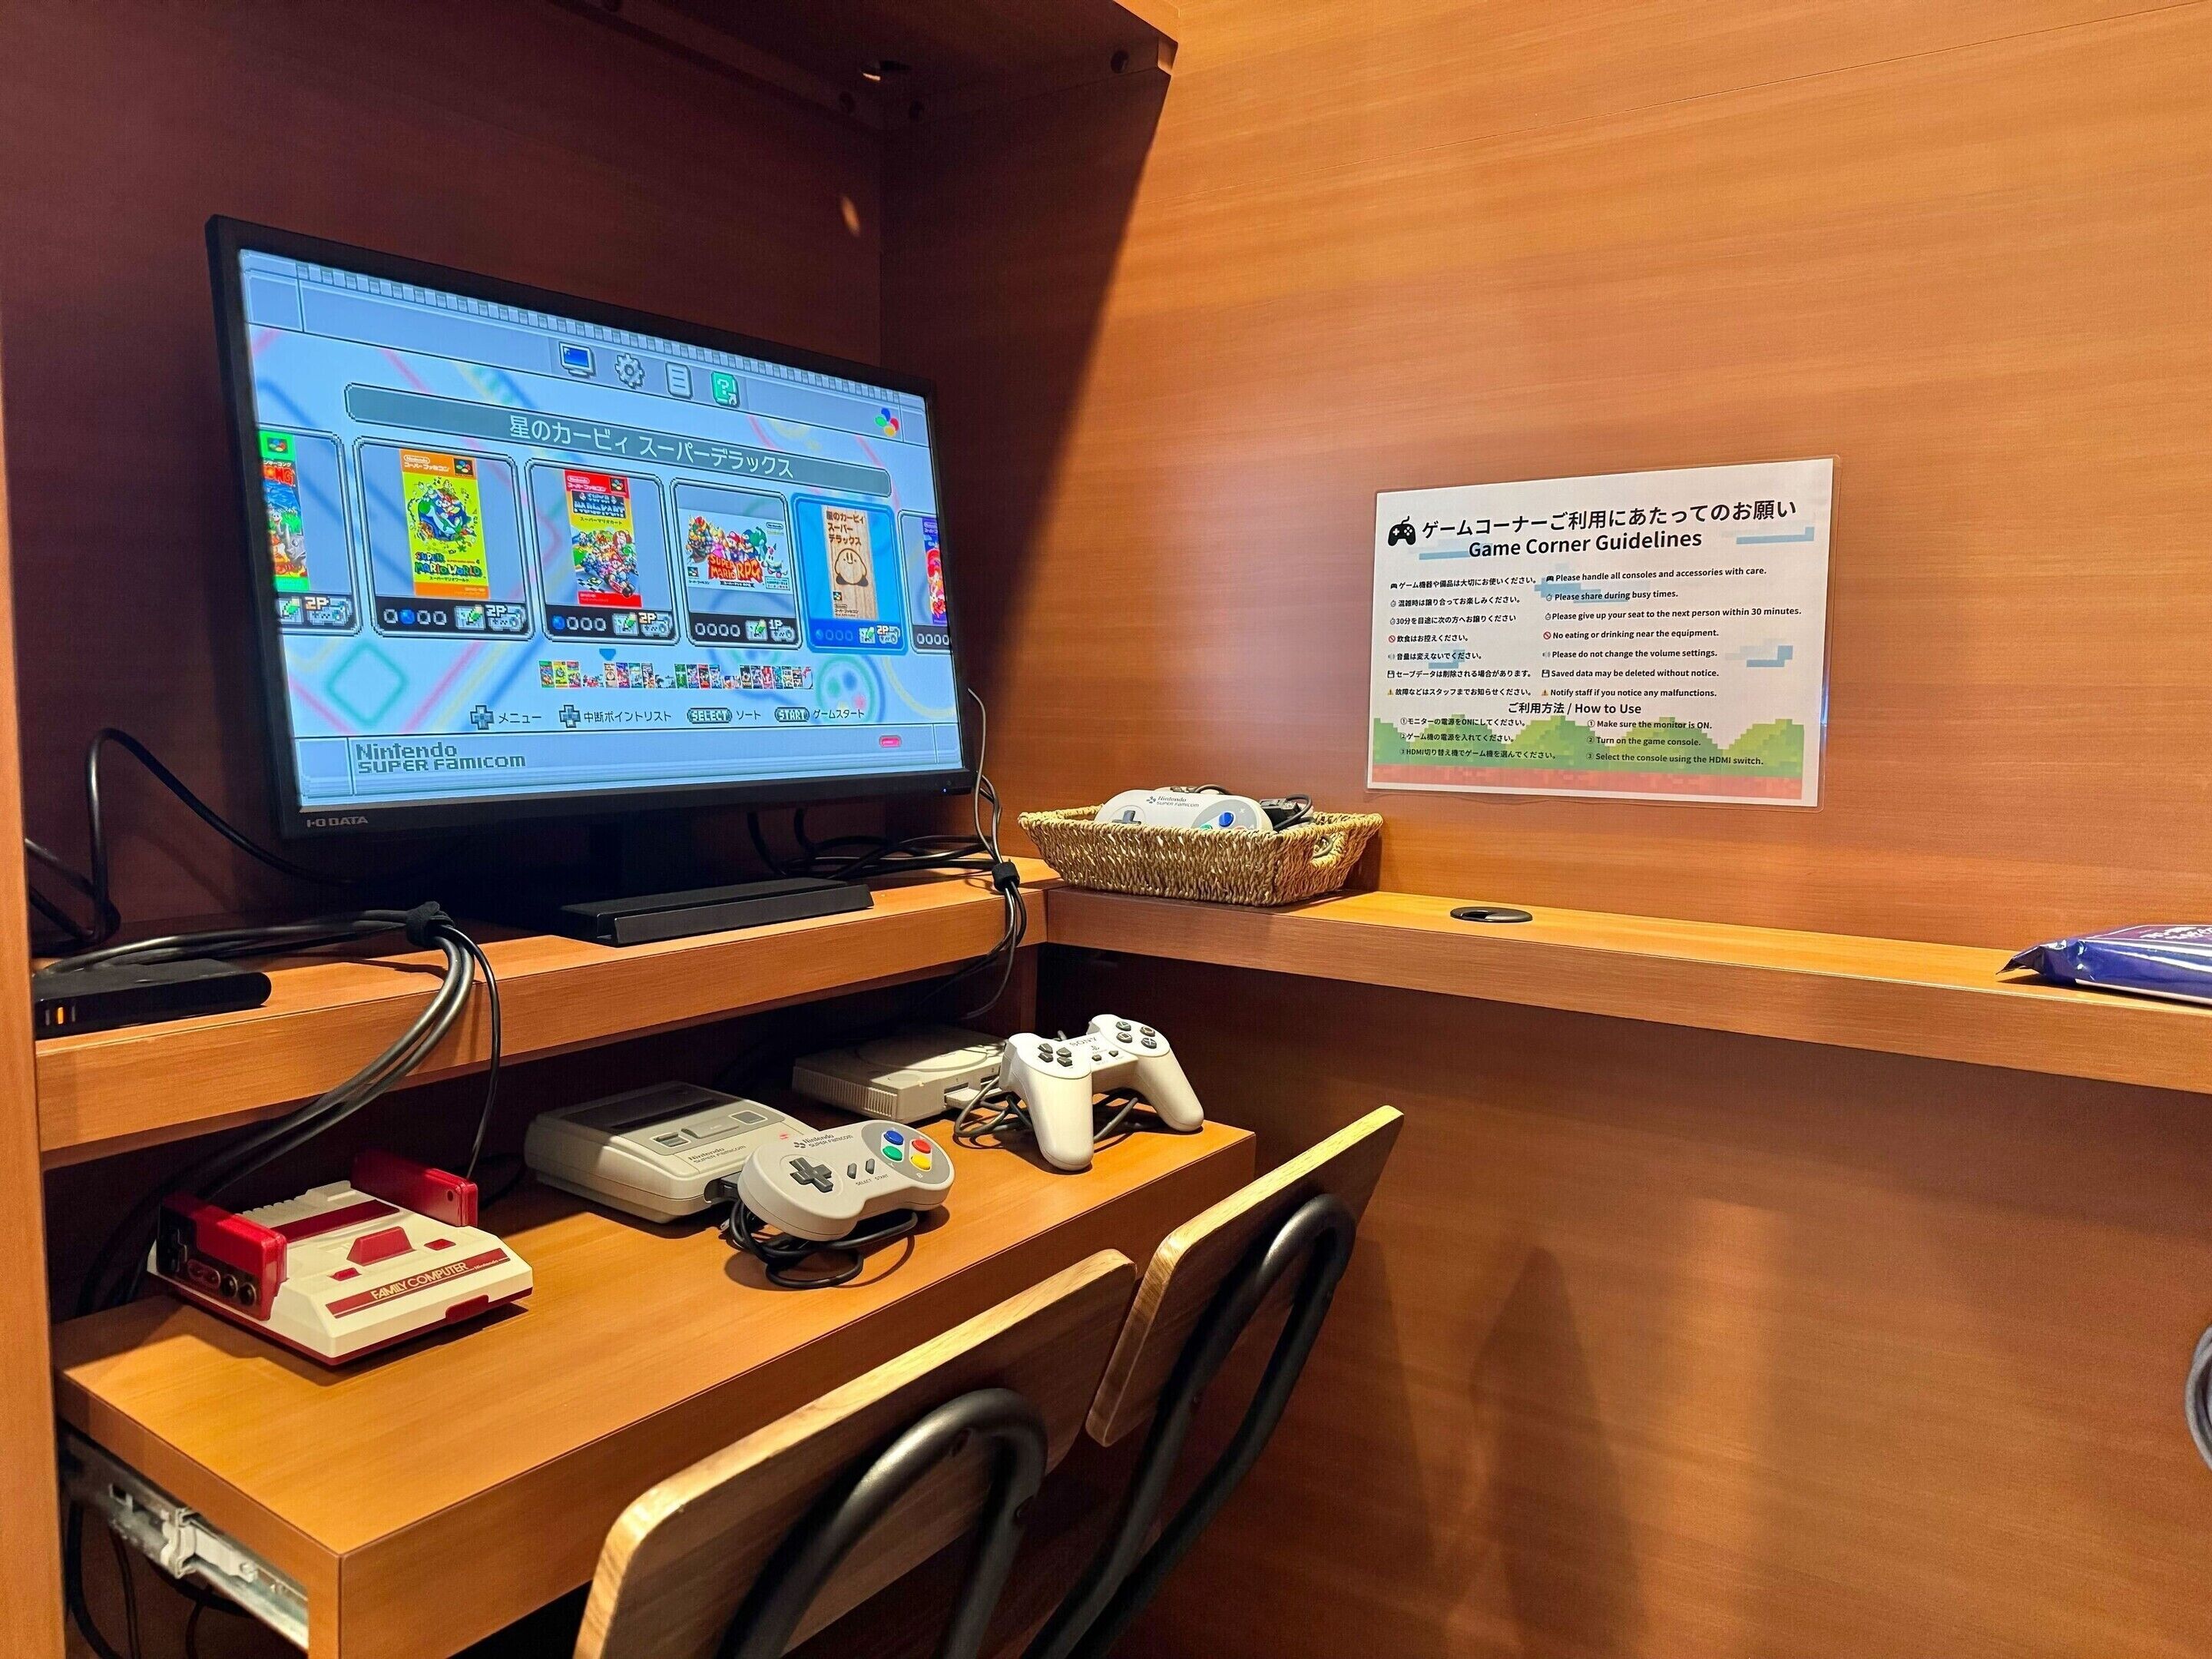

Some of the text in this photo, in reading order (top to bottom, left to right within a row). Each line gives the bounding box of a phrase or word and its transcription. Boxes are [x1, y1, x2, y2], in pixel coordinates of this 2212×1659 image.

[510, 415, 794, 478] 星のカービィ スーパーデラックス
[1422, 499, 1796, 538] ゲームコーナーご利用にあたってのお願い
[829, 534, 862, 546] デラックス
[1469, 531, 1702, 558] Game Corner Guidelines
[709, 554, 735, 570] SUPER
[710, 558, 763, 580] MARIO RPG
[1621, 571, 1656, 579] consoles
[1676, 568, 1723, 577] accessories
[1604, 591, 1630, 601] during
[1632, 591, 1651, 599] busy
[1692, 609, 1720, 618] person
[1722, 608, 1750, 616] within
[1763, 607, 1802, 615] minutes.
[1565, 631, 1589, 640] eating
[1601, 631, 1634, 639] drinking
[1671, 629, 1719, 637] equipment.
[1604, 650, 1633, 658] change
[1682, 649, 1717, 658] settings.
[1551, 689, 1573, 697] Notify
[813, 707, 865, 719] ゲームスタート
[1508, 702, 1565, 714] ご利用方法
[1575, 704, 1601, 714] How
[1604, 704, 1616, 714] to
[1620, 704, 1641, 714] Use
[498, 713, 541, 724] メニュー
[584, 710, 671, 724] 中断ポイントリスト
[690, 710, 730, 722] SELECT
[736, 710, 761, 720] ソート
[777, 709, 807, 720] START
[356, 742, 458, 760] Nintendo
[1596, 753, 1620, 761] Select
[1669, 755, 1691, 764] using
[1733, 757, 1763, 765] switch.
[358, 760, 429, 774] SUPER
[329, 816, 369, 826] DATA
[1070, 1037, 1098, 1047] SONY
[803, 1134, 835, 1144] Nintendo
[688, 1147, 725, 1161] Nintendo
[371, 1280, 409, 1300] FAMILY
[407, 1262, 469, 1288] COMPUTER
